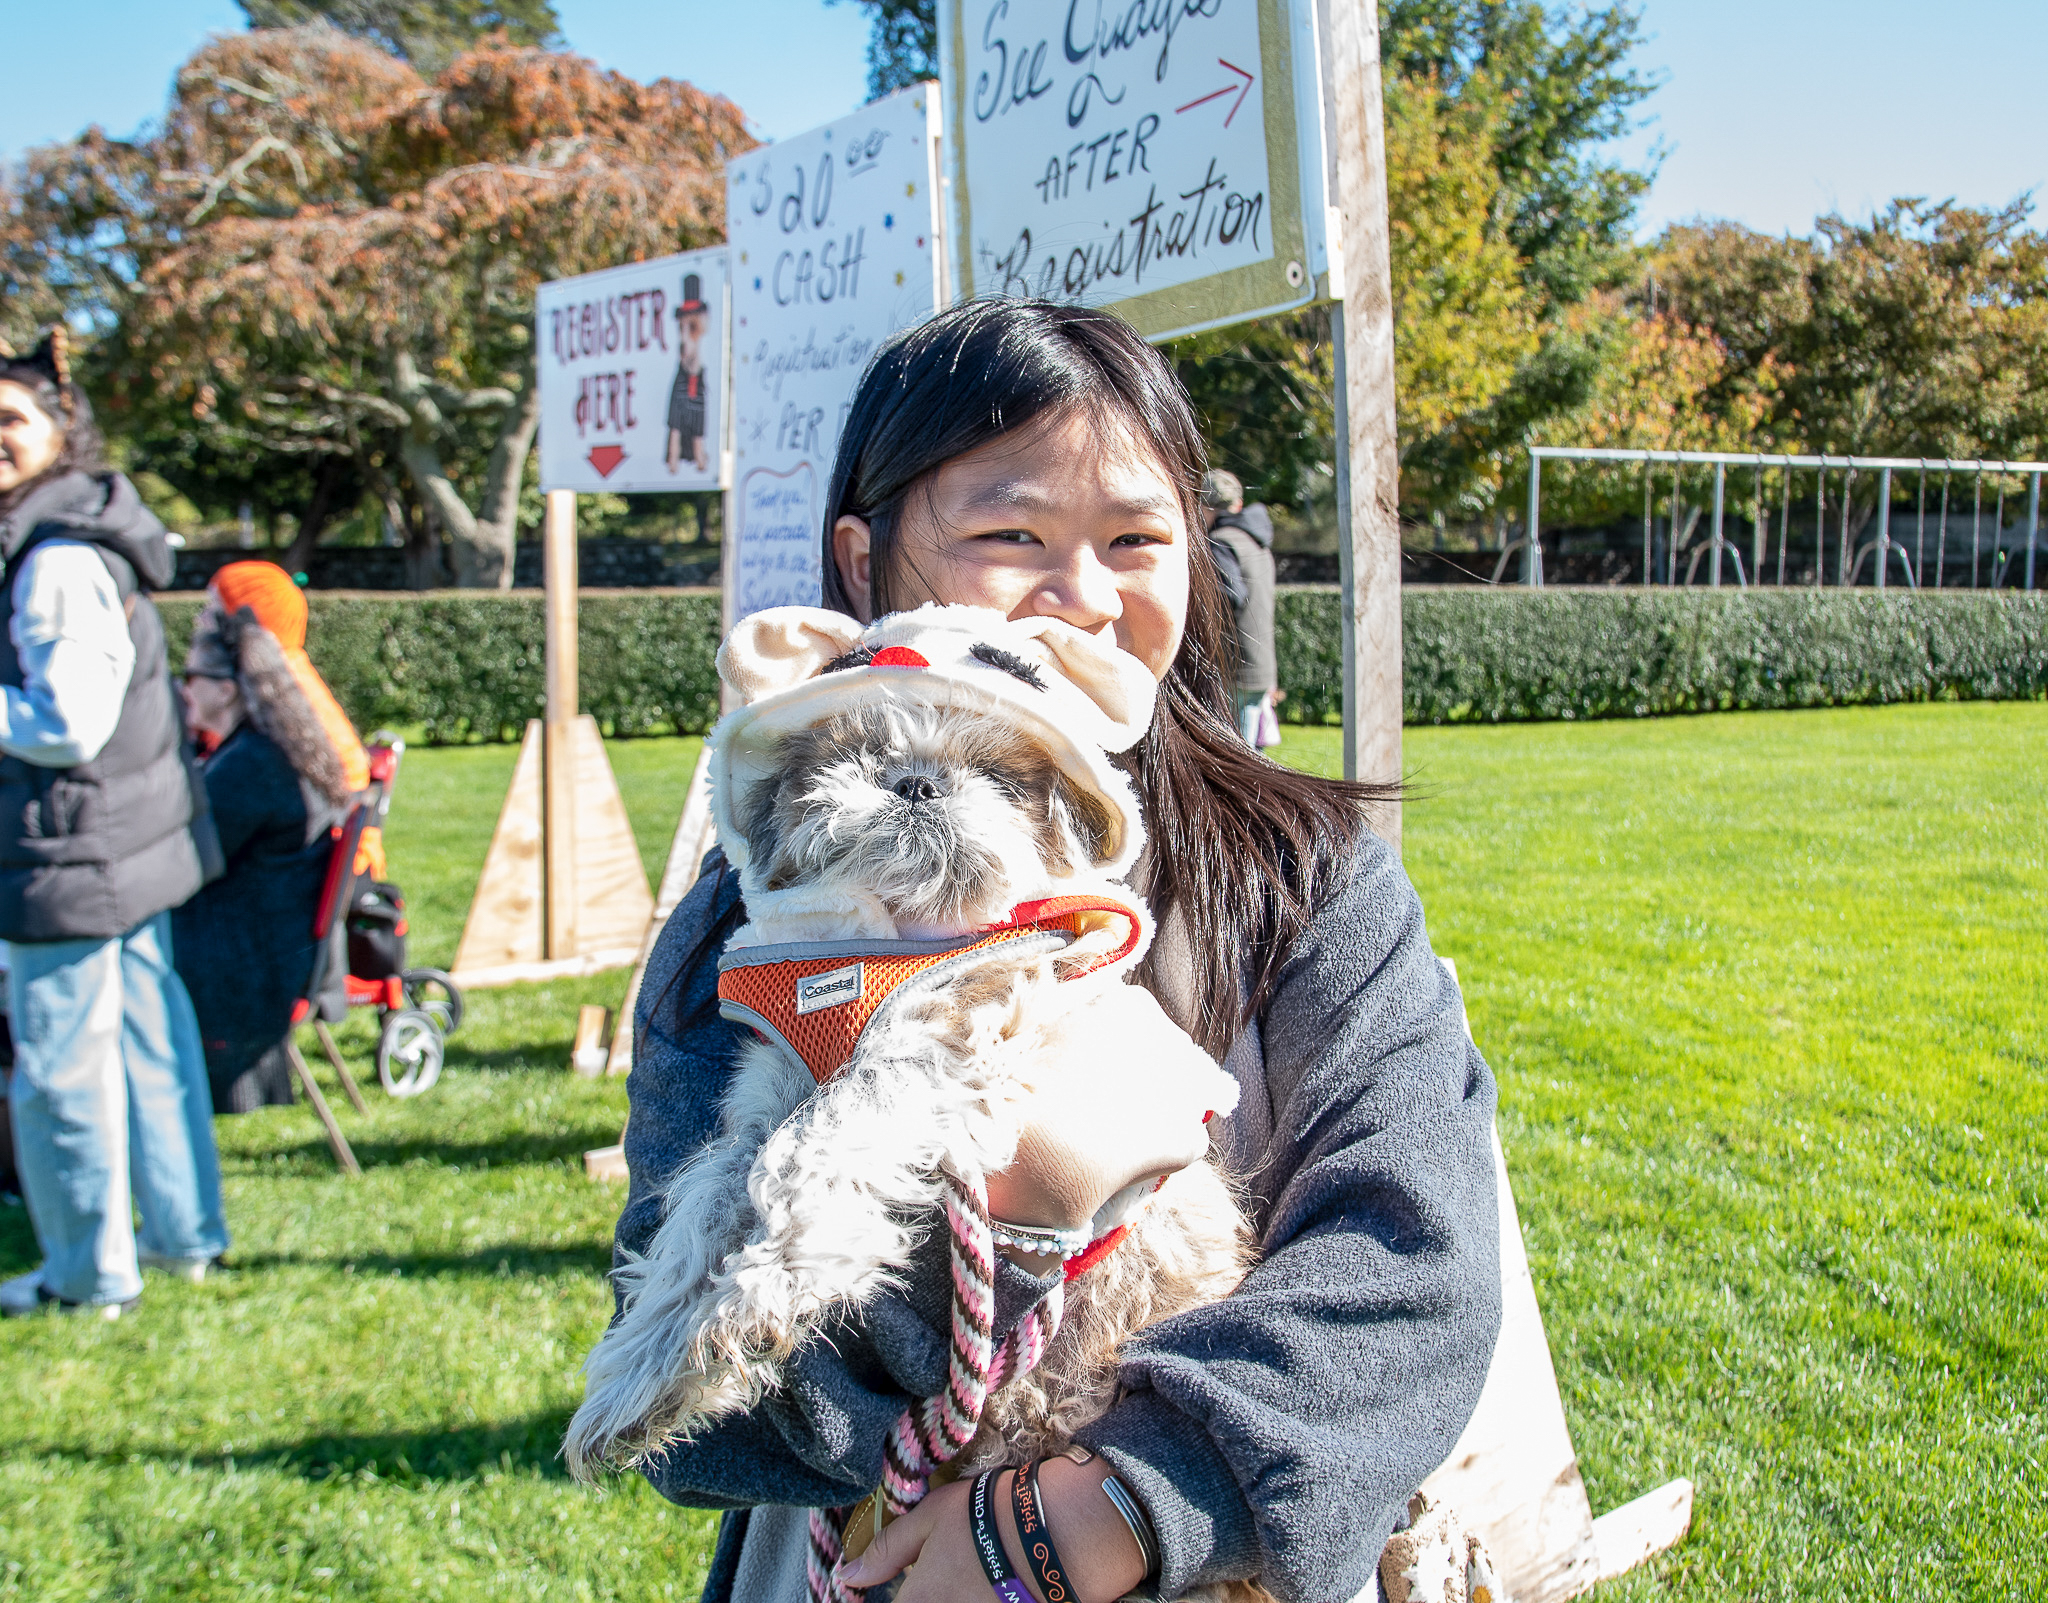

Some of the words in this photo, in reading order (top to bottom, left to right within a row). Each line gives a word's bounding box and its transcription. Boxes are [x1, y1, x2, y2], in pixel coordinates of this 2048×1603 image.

[973, 0, 1053, 121] See
[1035, 113, 1160, 203] AFTER
[772, 224, 866, 307] CASH
[552, 288, 669, 367] REGISTER
[575, 370, 637, 438] HERE
[776, 400, 825, 461] PER
[805, 976, 855, 997] Coastal
